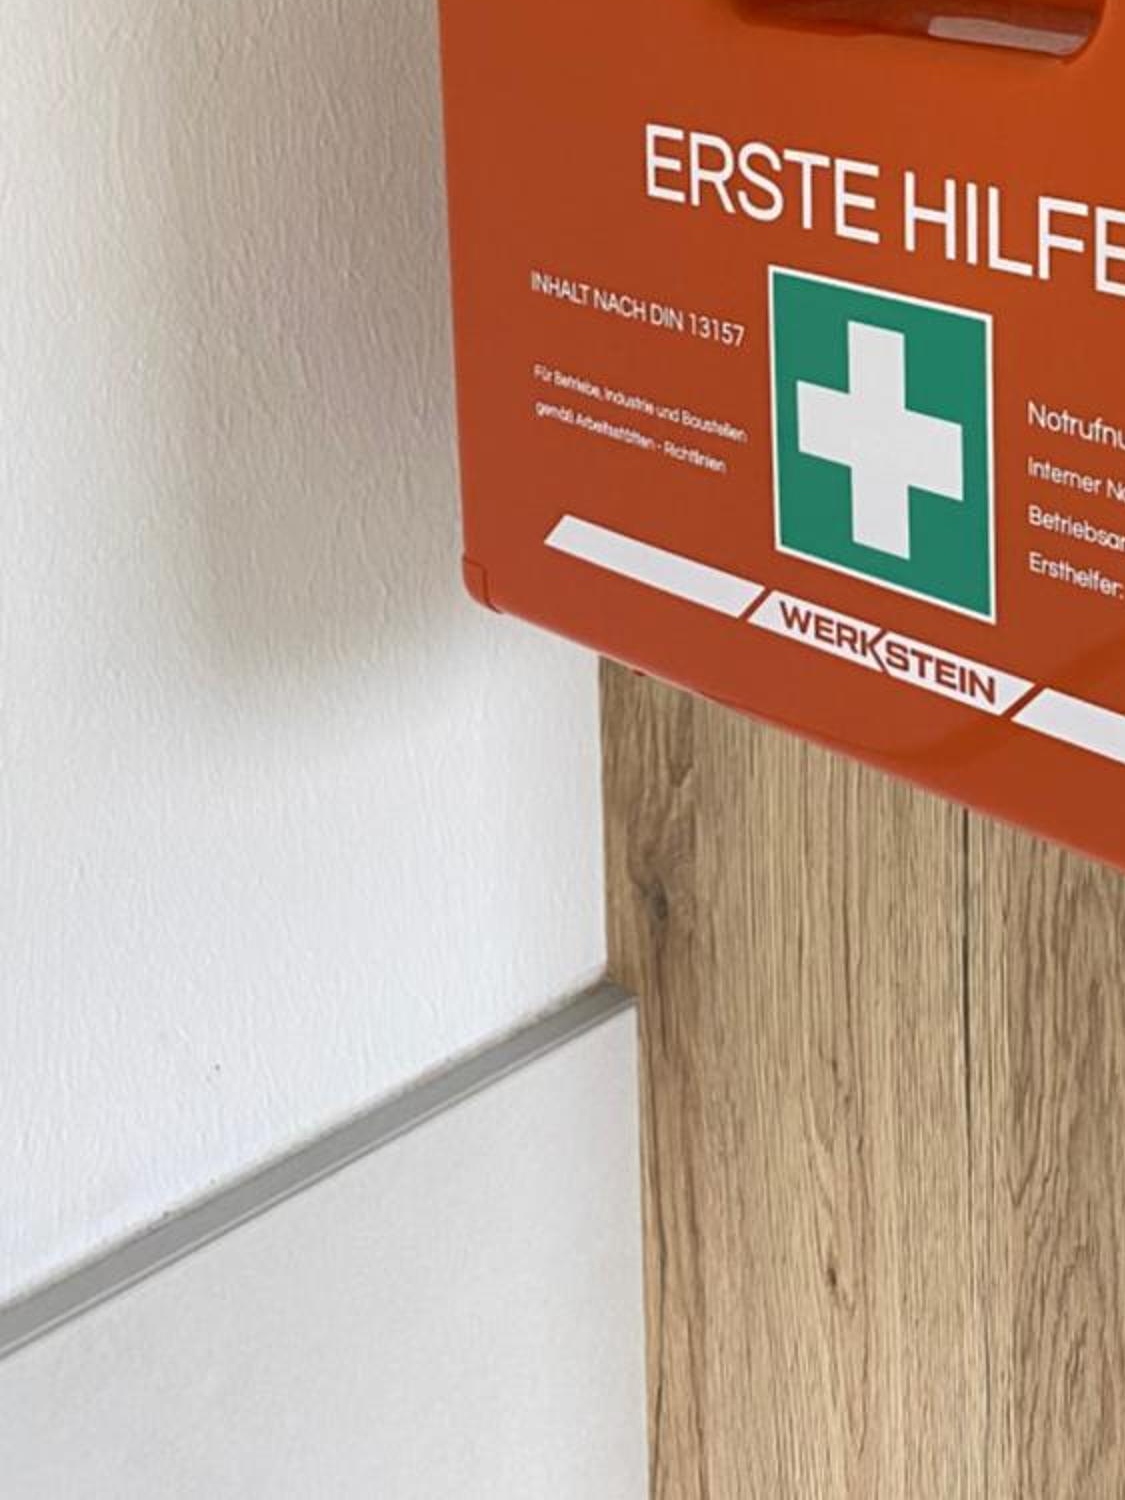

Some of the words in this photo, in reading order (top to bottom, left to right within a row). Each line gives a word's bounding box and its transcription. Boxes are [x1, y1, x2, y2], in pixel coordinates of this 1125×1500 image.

[645, 122, 881, 246] ERSTE
[531, 271, 591, 306] INHALT
[593, 289, 646, 322] NACH
[650, 303, 684, 332] DIN
[690, 313, 745, 346] 13157
[533, 364, 553, 383] Für
[553, 370, 603, 401] Betriebe,
[604, 386, 655, 415] Industrie
[656, 402, 680, 422] und
[681, 409, 748, 443] Baustellen
[663, 440, 726, 474] Richtlinien
[1027, 457, 1103, 495] Interner
[1028, 552, 1124, 600] Ersthelfer:
[779, 599, 996, 706] WERKSTEIN
